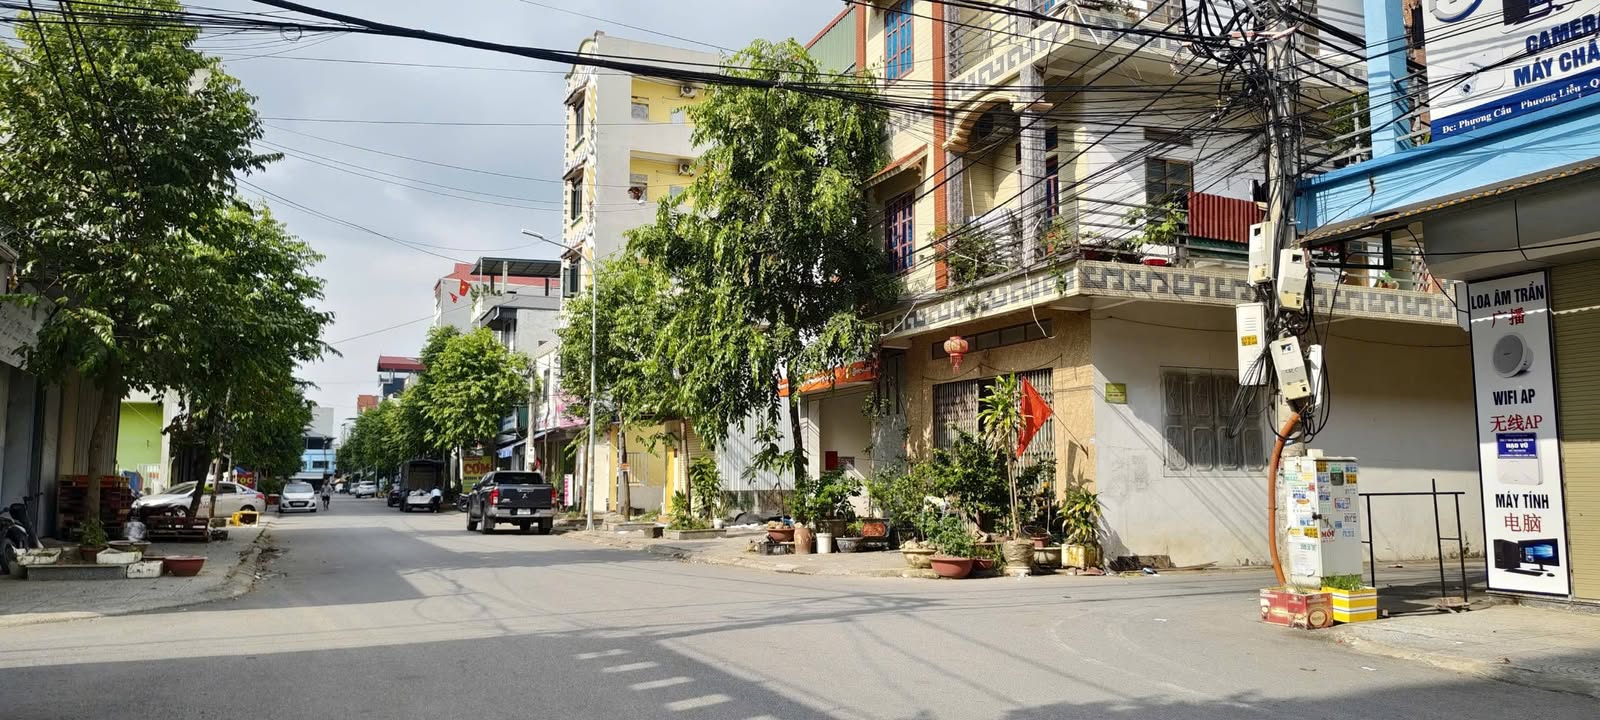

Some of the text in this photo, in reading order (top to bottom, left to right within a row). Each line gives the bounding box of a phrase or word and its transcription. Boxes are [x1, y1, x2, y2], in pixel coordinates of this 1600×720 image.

[1526, 11, 1600, 54] CAMER
[1514, 57, 1553, 87] MÁY
[1459, 113, 1492, 129] Phương
[1471, 293, 1491, 310] LOA
[1494, 289, 1511, 306] ÂM
[1492, 307, 1525, 328] 广播
[1493, 389, 1535, 405] WIFI AP
[1496, 491, 1549, 509] MÁY TÍNH
[1504, 513, 1542, 533] 电脑
